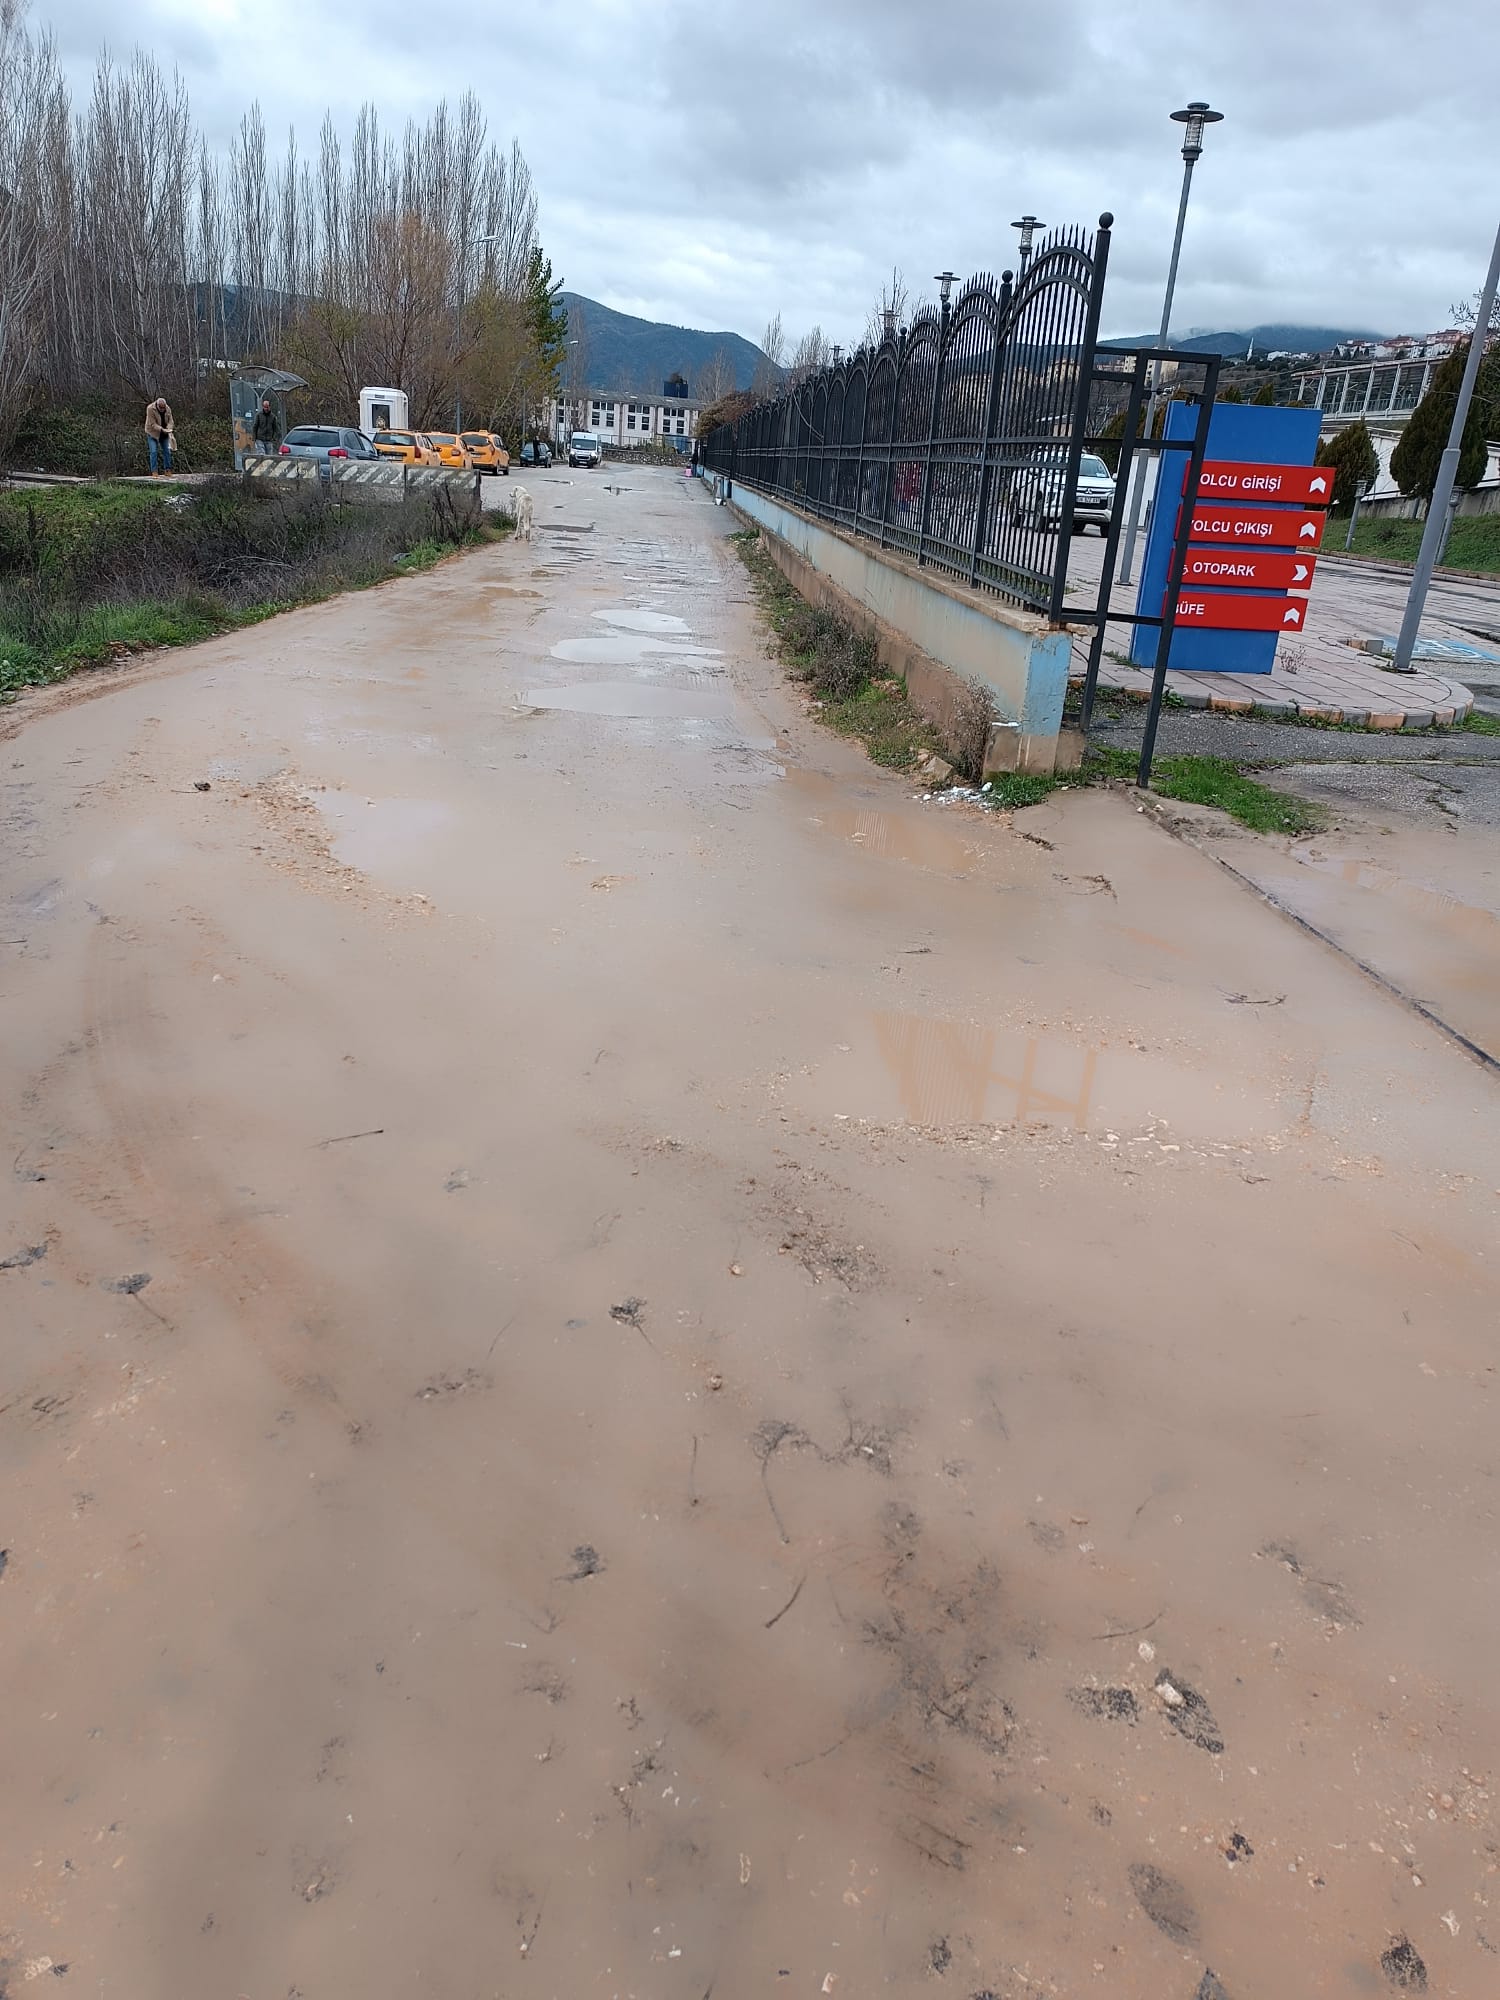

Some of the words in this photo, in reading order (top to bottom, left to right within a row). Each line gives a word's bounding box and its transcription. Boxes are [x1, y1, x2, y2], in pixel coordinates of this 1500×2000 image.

[1199, 473, 1237, 488] OLCU
[1241, 474, 1282, 492] GİRİŞİ
[1191, 519, 1230, 533] OLCU
[1234, 521, 1273, 537] ÇIKIŞI
[1192, 561, 1256, 577] OTOPARK
